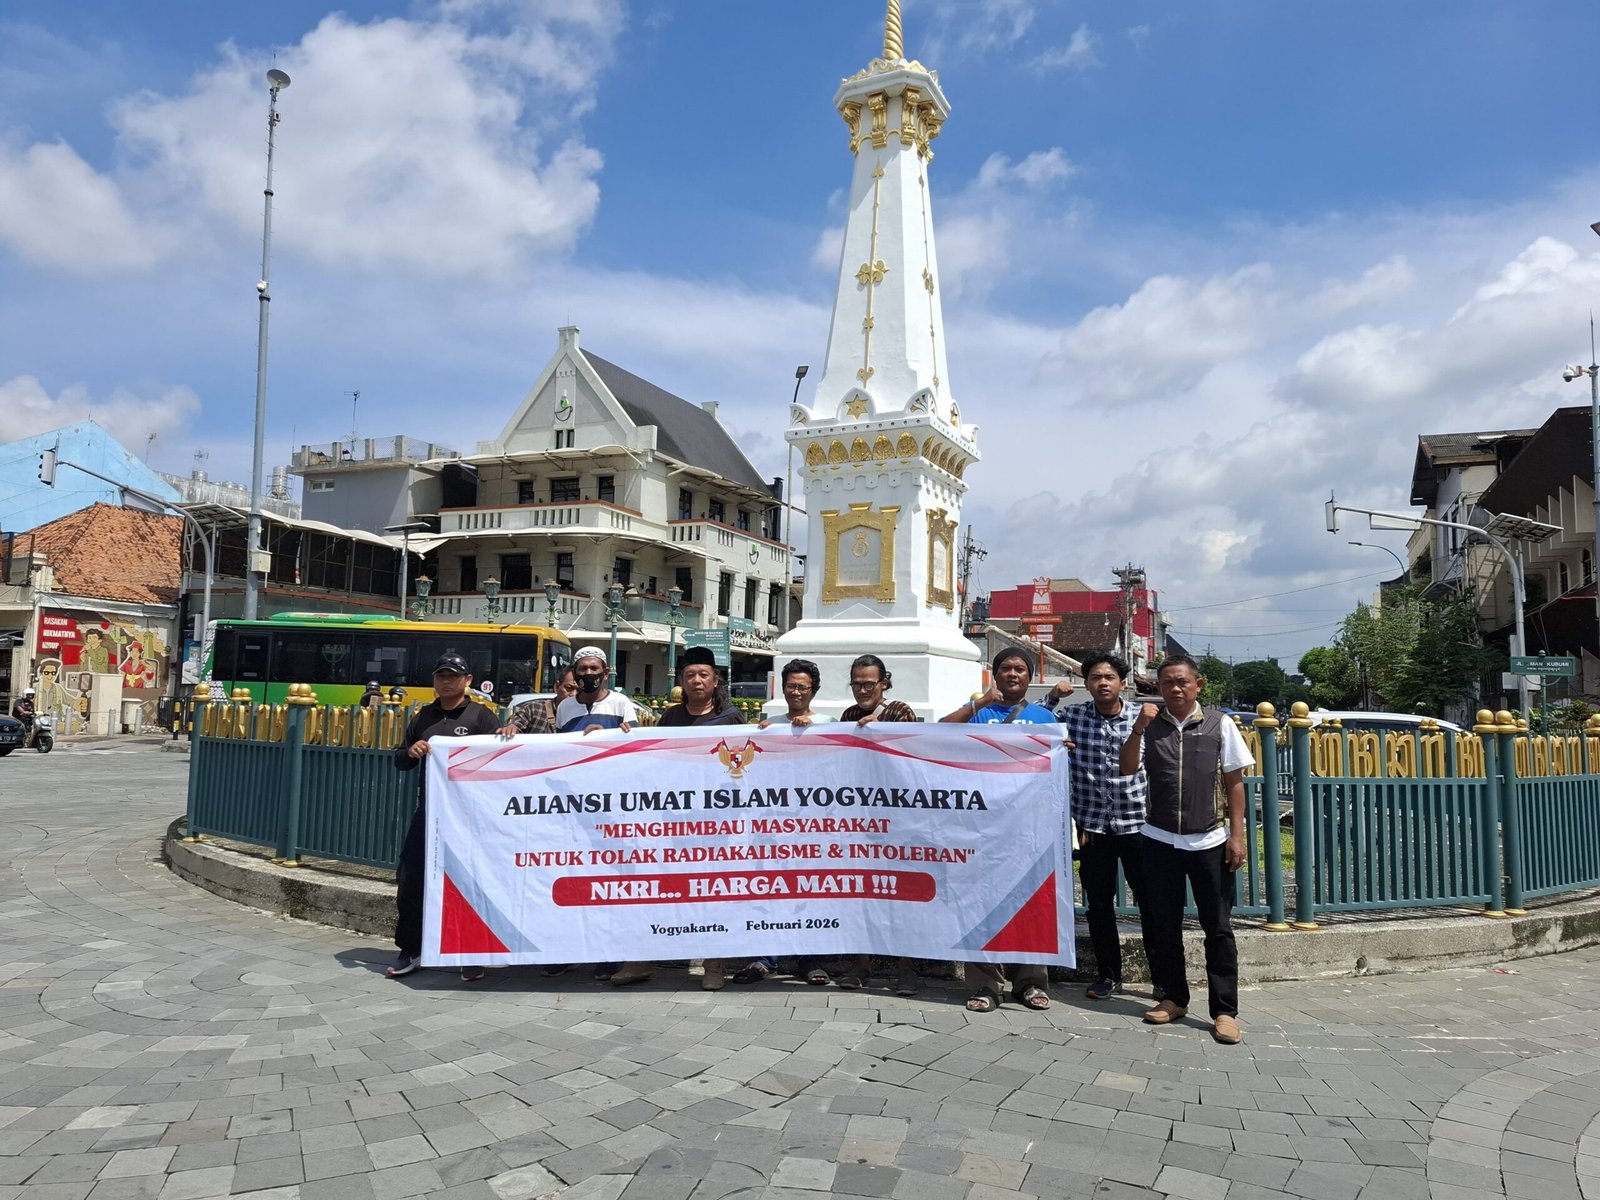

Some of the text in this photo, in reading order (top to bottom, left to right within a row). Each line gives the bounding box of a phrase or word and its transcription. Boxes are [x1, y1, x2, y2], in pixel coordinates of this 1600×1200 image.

[483, 683, 492, 691] 91
[503, 787, 988, 816] ALIANSI UMAT ISLAM YOGYAKARTA
[595, 818, 891, 839] "MENGHIMBAU MASYARAKAT
[514, 844, 976, 867] UNTUK TOLAK RADIAKALISME & INTOLERAN"
[590, 875, 898, 902] NKRI... HARGA MATI !!!
[650, 918, 840, 937] Yogyakarta, Februari 2026
